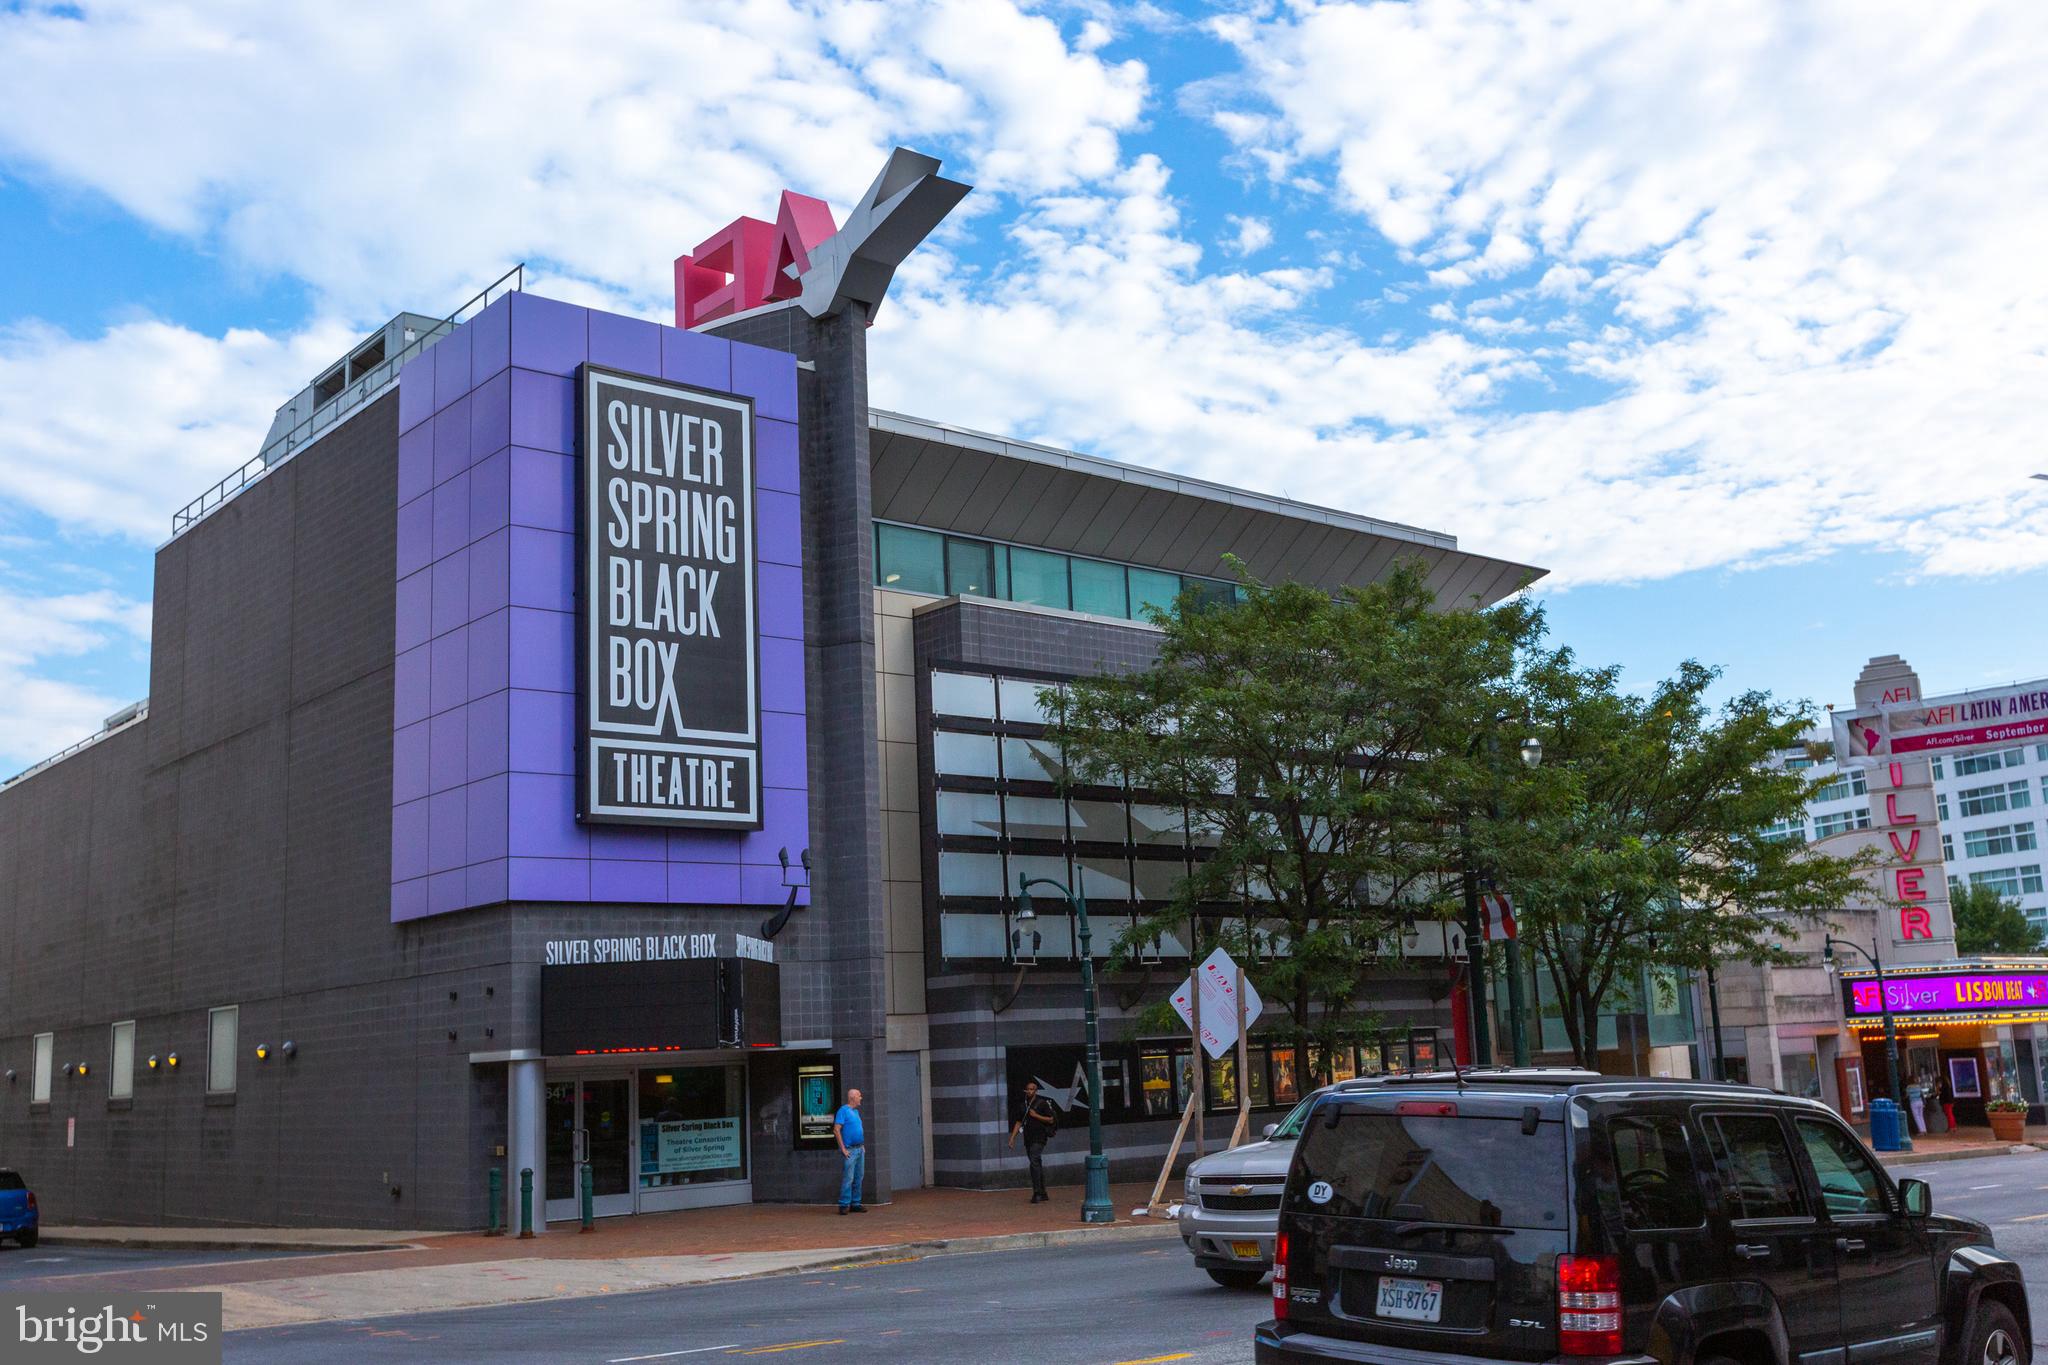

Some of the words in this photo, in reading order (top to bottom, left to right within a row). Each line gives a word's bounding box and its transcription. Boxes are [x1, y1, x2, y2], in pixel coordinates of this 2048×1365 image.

[608, 399, 723, 487] SILVER
[608, 477, 736, 564] SPRING
[609, 556, 721, 638] BLACK
[609, 635, 682, 734] BOX
[1882, 687, 1911, 704] AFI
[1925, 706, 1955, 727] AFI
[1961, 700, 2002, 721] LATIN
[1926, 734, 1975, 746] AFI.com/Silver
[1985, 724, 2045, 740] September
[613, 752, 735, 808] THEATRE
[546, 939, 589, 966] SILVER
[593, 937, 641, 963] SPRING
[646, 935, 687, 961] BLACK
[691, 933, 717, 959] BOX
[1887, 983, 1940, 1009] Silver
[1955, 980, 2005, 1002] LISBON
[2005, 980, 2023, 1000] BEAT
[1064, 1059, 1130, 1112] AFI
[662, 1123, 680, 1133] Silver
[681, 1121, 703, 1132] Spring
[704, 1121, 721, 1130] Black
[722, 1120, 734, 1129] Box
[694, 1135, 732, 1144] Consortium
[683, 1145, 701, 1153] Silver
[703, 1144, 725, 1153] Spring
[1314, 1184, 1328, 1196] DY
[1384, 1254, 1418, 1273] Jeep
